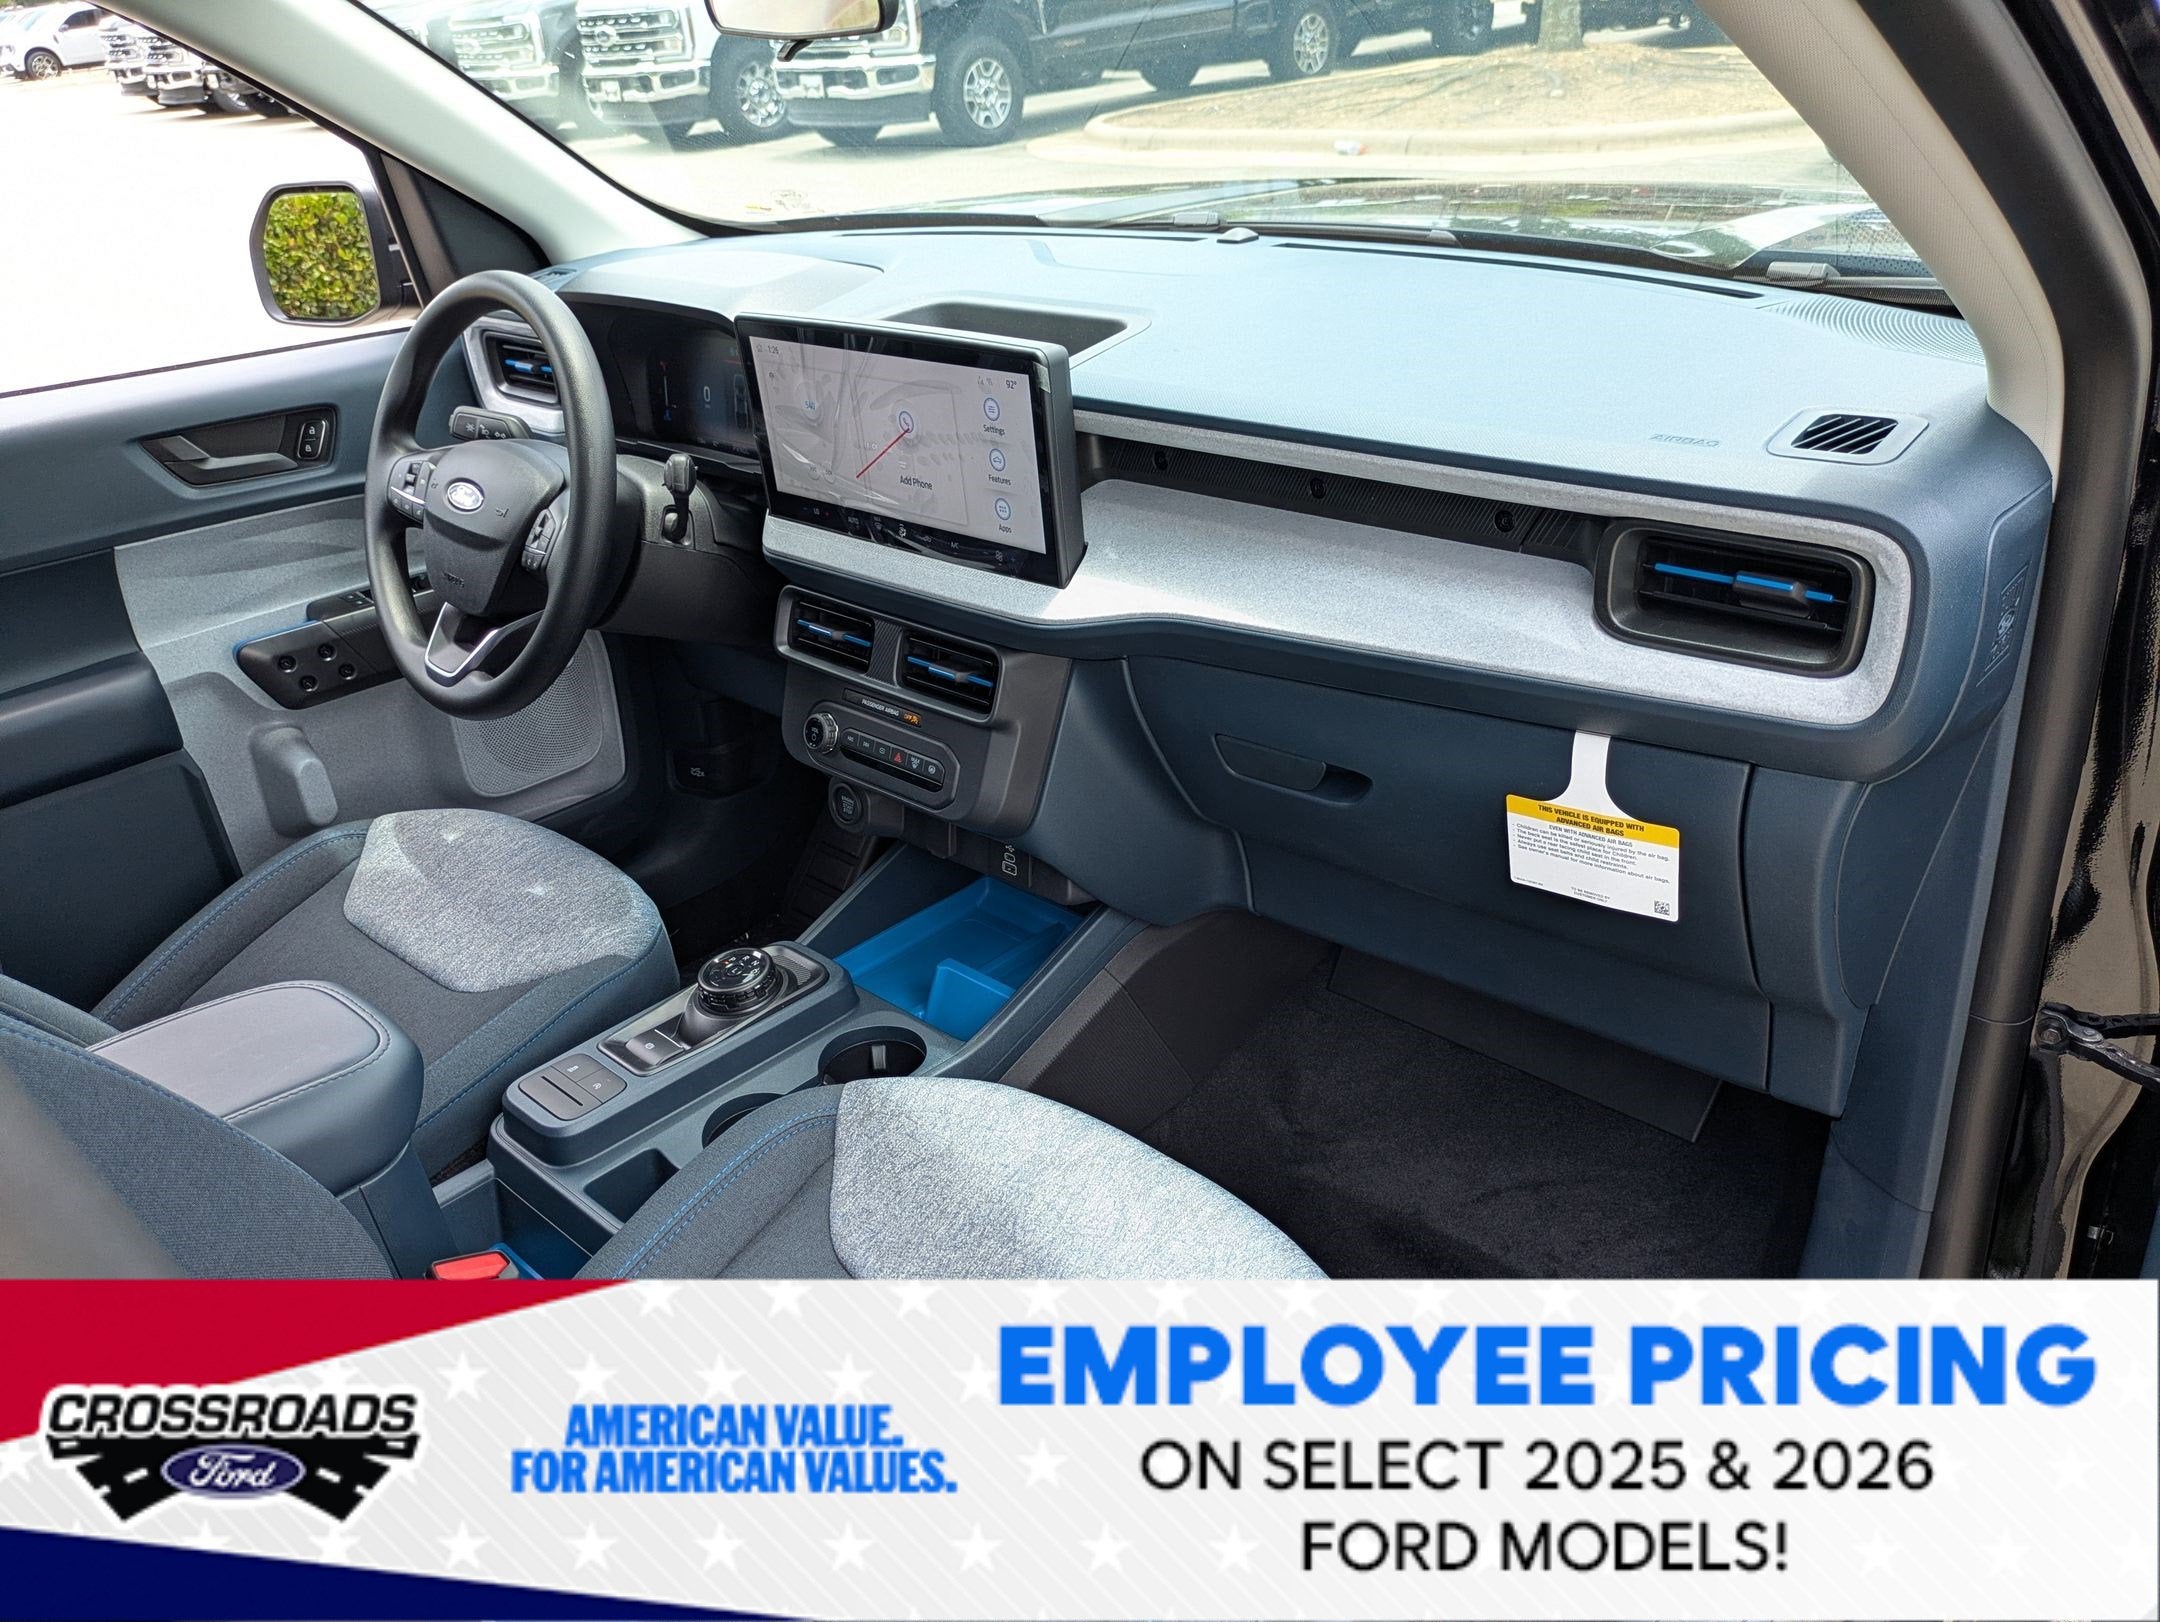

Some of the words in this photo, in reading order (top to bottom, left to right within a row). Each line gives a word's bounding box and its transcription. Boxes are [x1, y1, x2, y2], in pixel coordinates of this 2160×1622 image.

[983, 425, 1005, 436] Settings
[900, 476, 912, 486] Add
[913, 478, 933, 490] Phone
[989, 474, 1011, 485] Features
[998, 524, 1012, 533] Apps
[862, 699, 884, 711] PASSENGER
[885, 707, 899, 716] AIRBAG
[1538, 805, 1552, 813] THIS
[1554, 808, 1582, 819] VEHICLE
[1591, 816, 1624, 828] EQUIPPED
[1626, 822, 1644, 831] WITH
[1556, 817, 1590, 829] ADVANCED
[1606, 828, 1624, 836] BAGS
[1517, 824, 1538, 832] Children
[1581, 839, 1605, 849] seriously
[1607, 844, 1627, 852] injured
[1518, 839, 1535, 847] Always
[1579, 832, 1605, 841] ADVANCED
[1560, 844, 1576, 852] facing
[1587, 845, 1601, 853] place
[1612, 851, 1638, 860] Children.
[1550, 852, 1569, 860] manual
[1594, 862, 1626, 874] information
